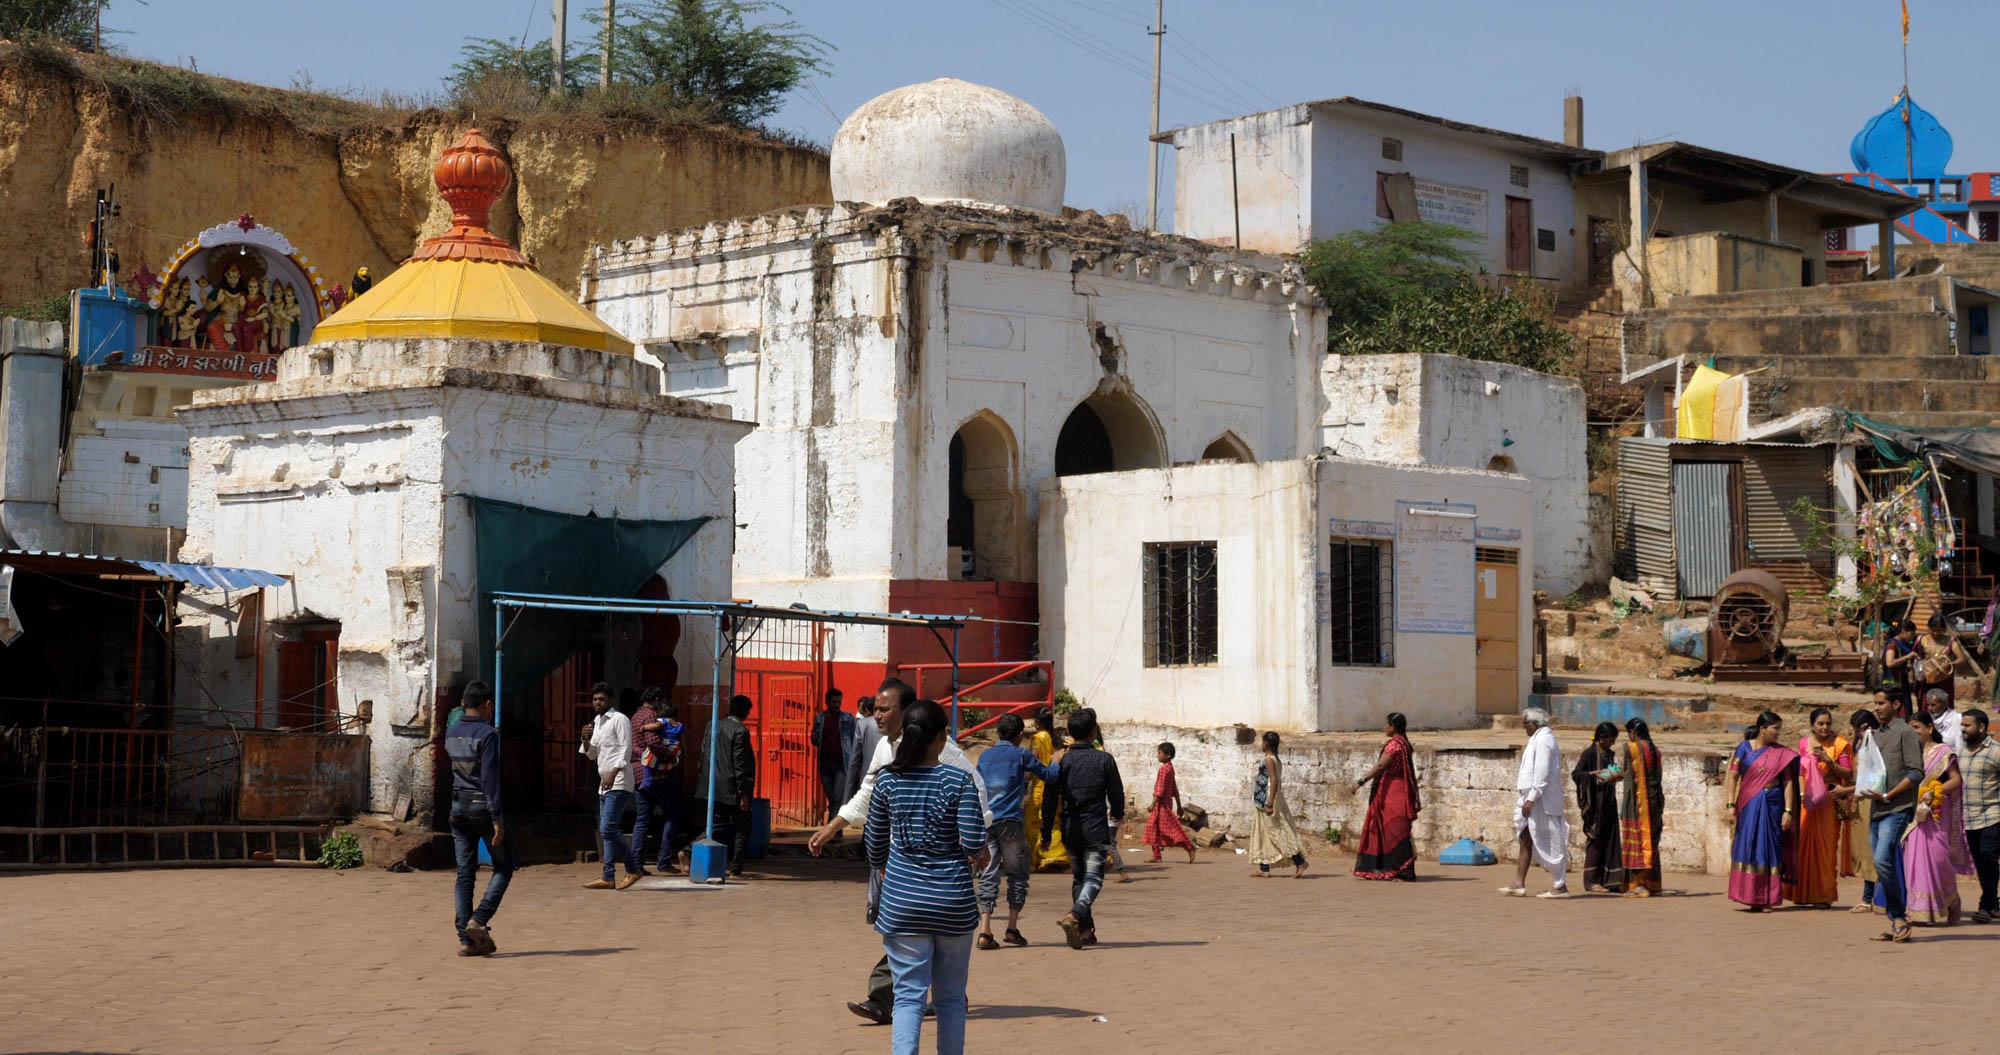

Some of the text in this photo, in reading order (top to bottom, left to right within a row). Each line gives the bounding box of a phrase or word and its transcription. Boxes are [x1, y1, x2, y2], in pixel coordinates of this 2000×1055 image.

[132, 348, 153, 367] श्री
[158, 348, 189, 369] क्षेत्र
[193, 353, 245, 373] झरणी
